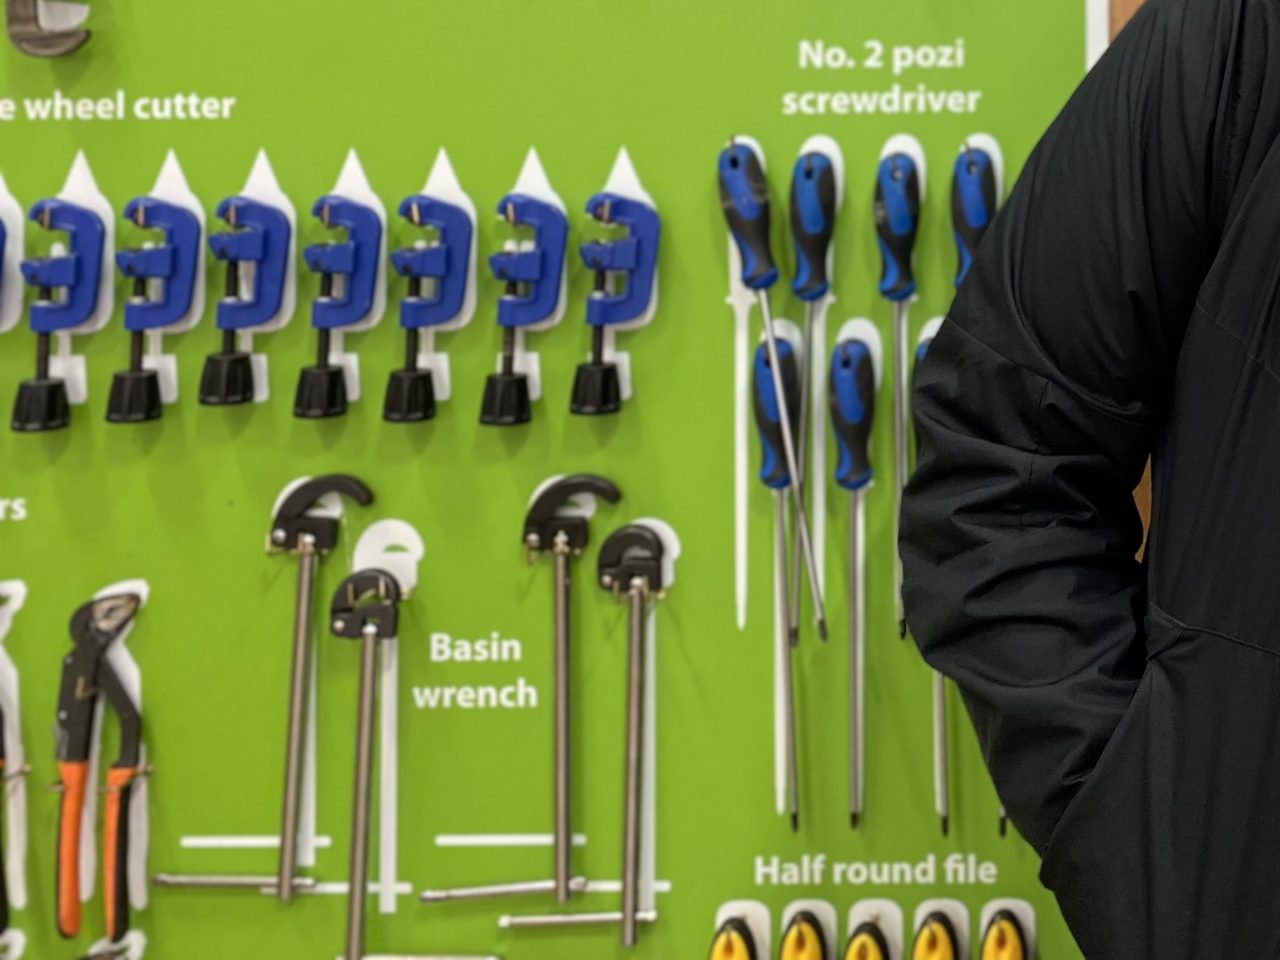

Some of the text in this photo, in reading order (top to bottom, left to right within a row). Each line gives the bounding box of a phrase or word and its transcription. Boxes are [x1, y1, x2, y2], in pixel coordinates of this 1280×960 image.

[799, 38, 965, 75] No. 2 pozi
[23, 89, 125, 120] wheel
[133, 93, 236, 120] cutter
[782, 83, 981, 115] screwdriver
[430, 631, 522, 662] Basin
[412, 677, 538, 709] wrench
[754, 852, 998, 885] Half round file
